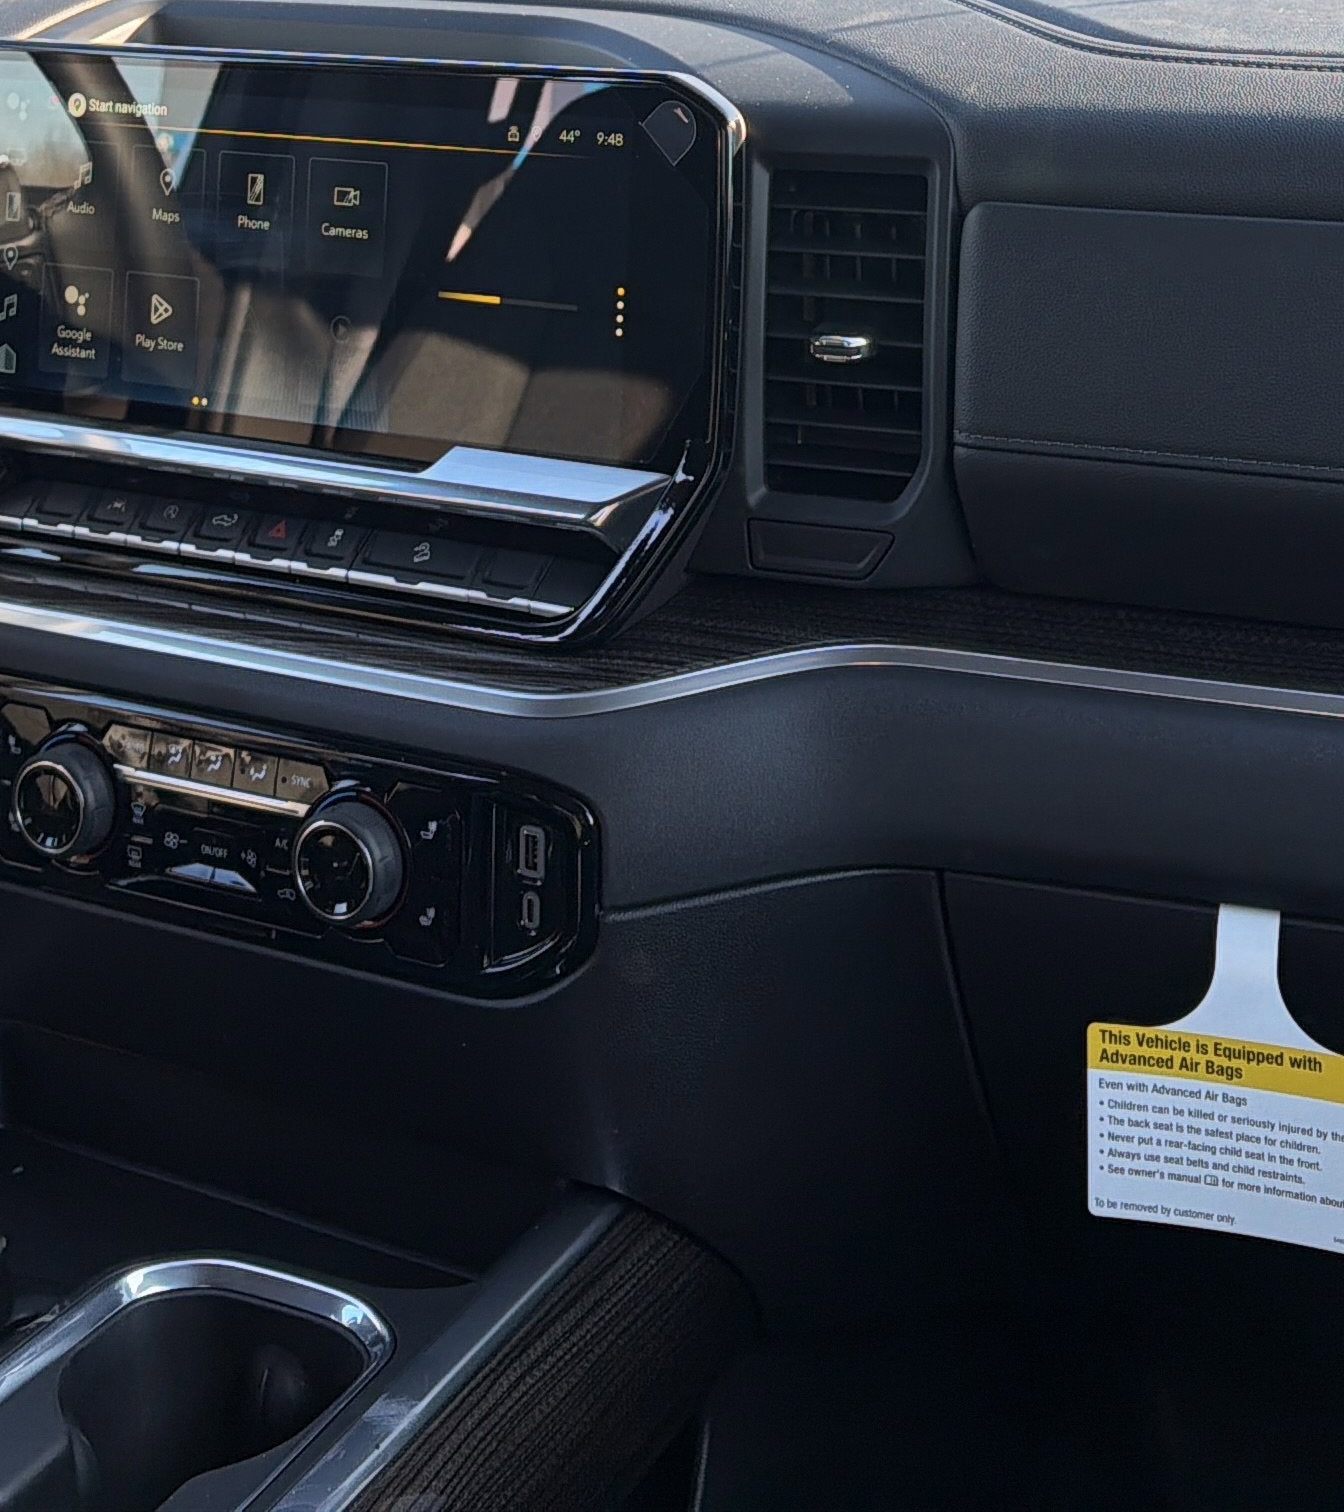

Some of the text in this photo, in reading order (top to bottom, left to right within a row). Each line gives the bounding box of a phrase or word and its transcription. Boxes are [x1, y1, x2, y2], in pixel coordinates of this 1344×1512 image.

[88, 98, 168, 119] Start navigation
[596, 131, 623, 146] 9:48
[67, 201, 95, 216] Audio
[152, 208, 181, 225] Maps
[237, 215, 271, 231] Phone
[321, 222, 369, 240] Cameras
[57, 326, 92, 343] Google
[135, 334, 184, 353] Play Store
[51, 343, 96, 360] Assistant
[291, 776, 312, 787] SYNC
[201, 844, 228, 858] ON/OFF
[275, 837, 289, 850] A/C
[1099, 1029, 1322, 1073] This Vehicle is Equipped with
[1099, 1048, 1243, 1081] Advanced Air Bags
[1099, 1078, 1247, 1107] Even with Advanced Air Bags
[1108, 1099, 1148, 1112] Children
[1152, 1105, 1169, 1114] can
[1173, 1106, 1184, 1117] be
[1188, 1108, 1215, 1121] killed
[1217, 1114, 1228, 1123] or
[1231, 1116, 1275, 1132] seriously
[1279, 1121, 1313, 1137] injured
[1316, 1128, 1328, 1141] by
[1107, 1115, 1320, 1155] The back seat is the safest place for children.
[1108, 1131, 1322, 1171] Never put a rear-facing child seat in the front.
[1107, 1148, 1305, 1184] Always use seat belts and child restraints.
[1108, 1164, 1125, 1175] See
[1128, 1168, 1165, 1179] owner's
[1167, 1172, 1201, 1184] manual
[1222, 1178, 1234, 1188] for
[1237, 1182, 1261, 1193] more
[1264, 1184, 1317, 1203] information
[1094, 1197, 1236, 1226] To be removed by customer only.
